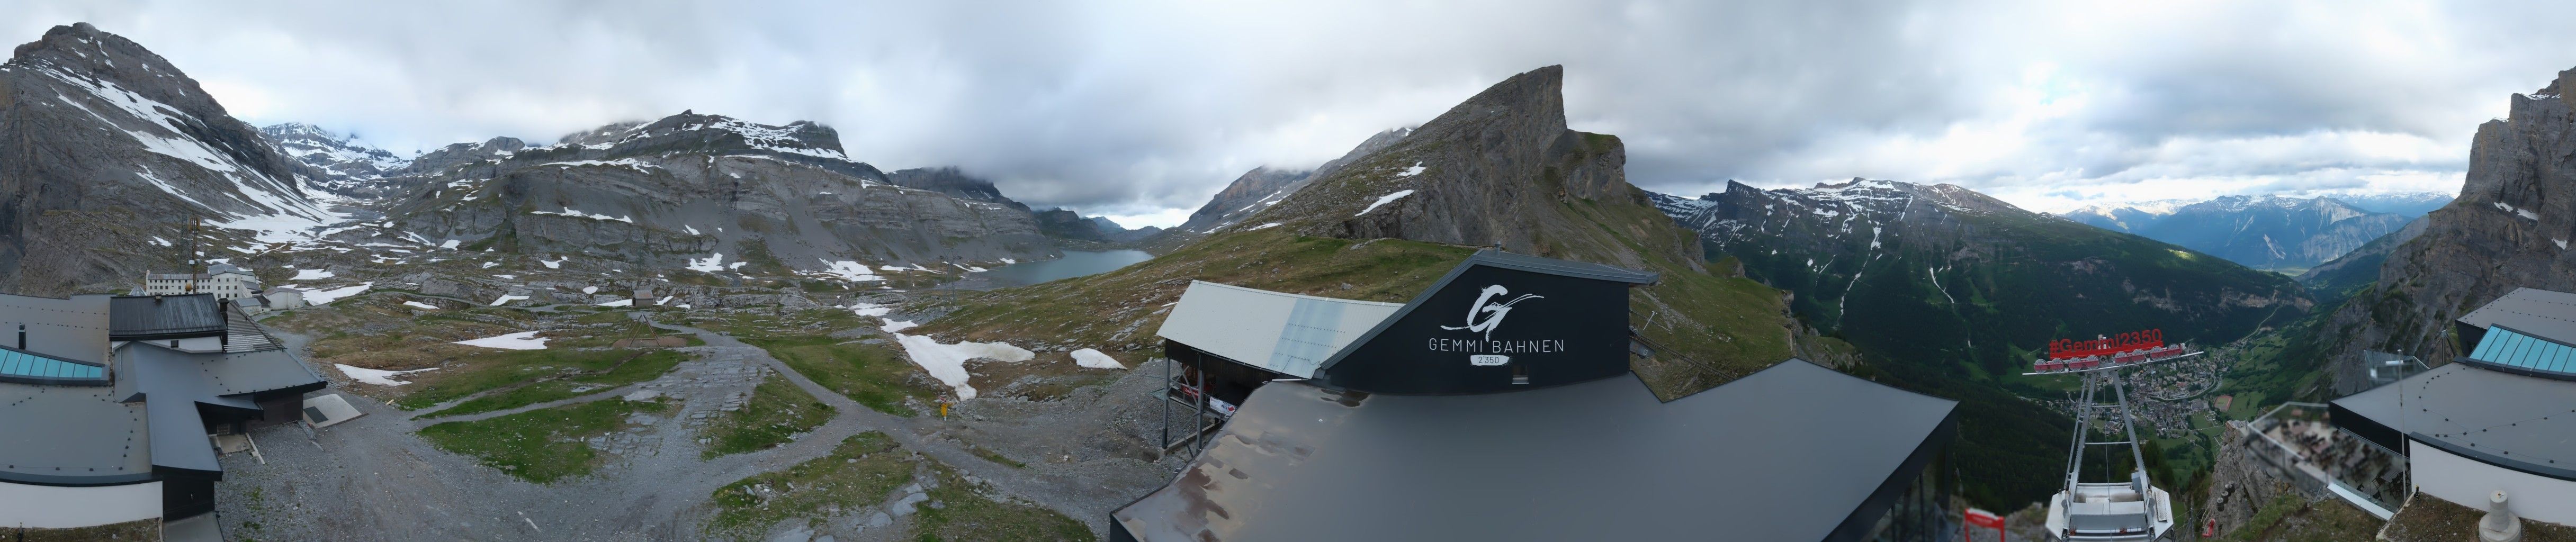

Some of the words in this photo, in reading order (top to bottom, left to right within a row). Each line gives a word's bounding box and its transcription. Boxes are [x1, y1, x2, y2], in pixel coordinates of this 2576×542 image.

[1429, 338, 1483, 352] GEMMI
[1492, 339, 1564, 353] BAHNEN
[2049, 328, 2163, 353] #Gemmi2350
